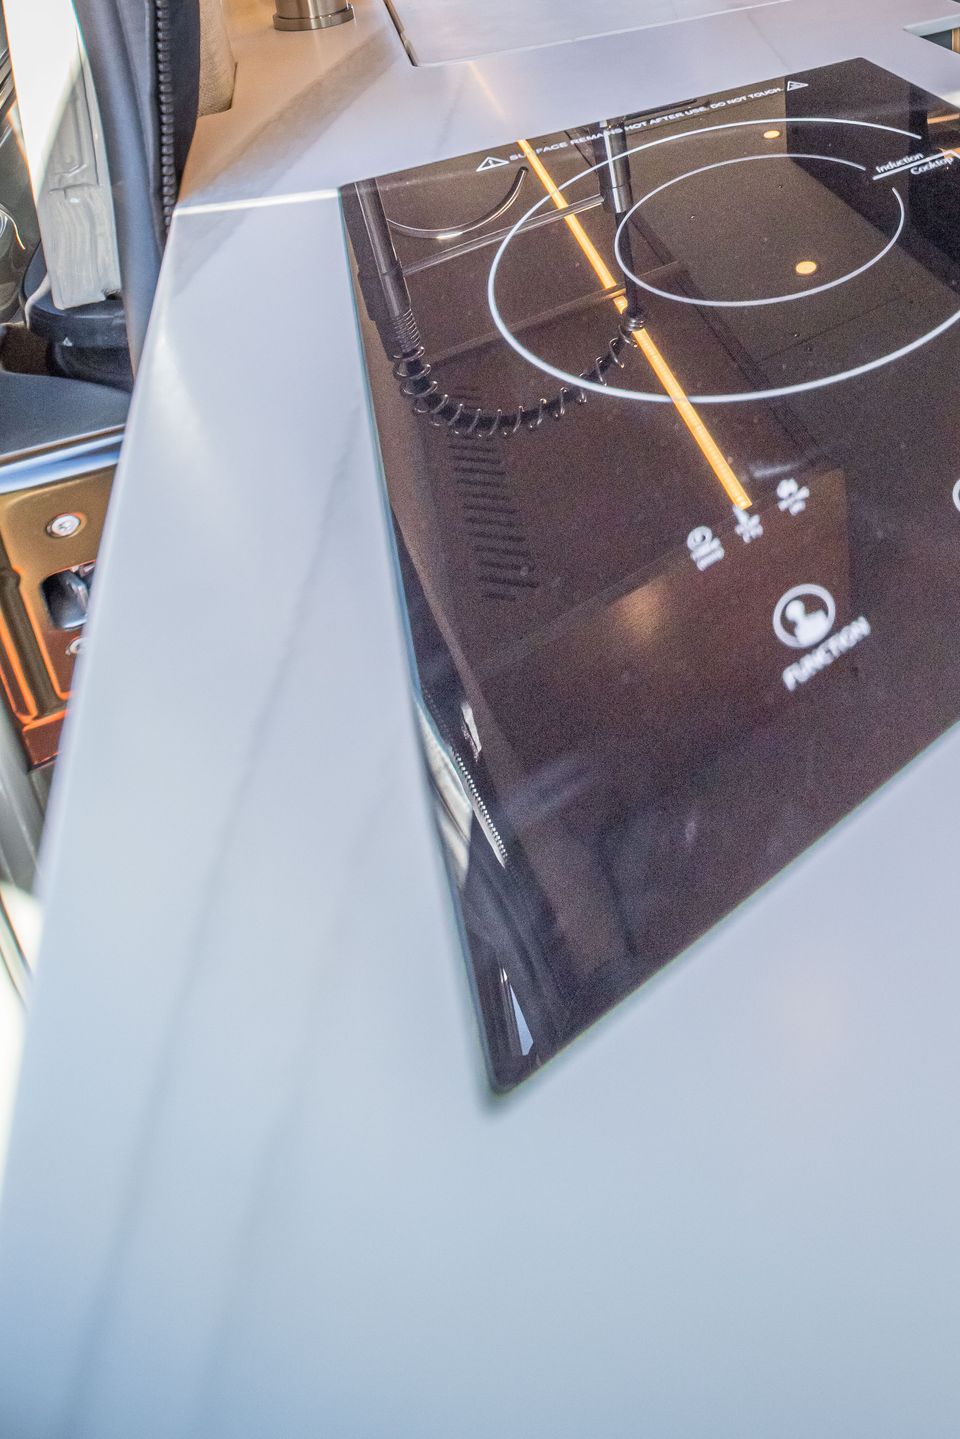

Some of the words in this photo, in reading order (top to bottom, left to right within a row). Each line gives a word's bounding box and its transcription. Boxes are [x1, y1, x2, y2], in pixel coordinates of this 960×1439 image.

[509, 141, 569, 161] SUFACE
[625, 120, 648, 132] HOT
[649, 111, 686, 125] AFTER
[875, 153, 925, 173] Induction
[910, 157, 954, 175] Cooktop
[783, 616, 871, 691] FUNCTION
